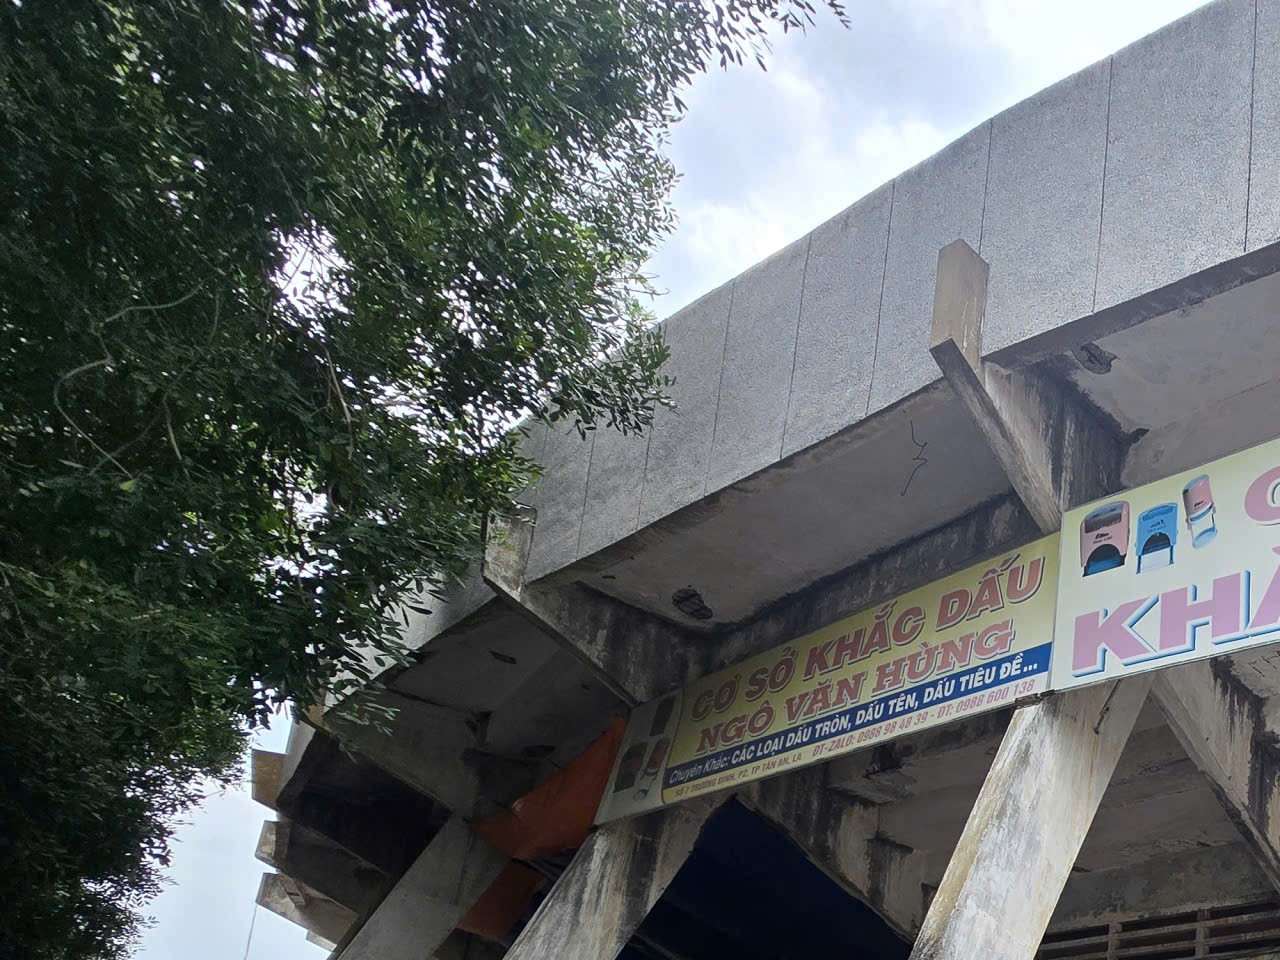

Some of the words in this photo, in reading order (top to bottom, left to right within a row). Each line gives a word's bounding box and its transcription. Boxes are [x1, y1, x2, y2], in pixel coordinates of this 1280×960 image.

[691, 674, 742, 721] CƠ
[745, 646, 798, 701] SỞ
[803, 601, 925, 681] KHẮC
[936, 554, 1045, 632] DẤU
[695, 700, 776, 755] NGÔ
[784, 671, 867, 726] VĂN
[871, 617, 1016, 697] HÙNG
[1013, 679, 1036, 695] 138
[731, 744, 755, 765] CÁC
[756, 735, 784, 757] LOẠI
[786, 723, 812, 747] DẤU
[815, 714, 851, 738] TRÒN,
[855, 701, 885, 726] DẤU
[887, 692, 918, 716] TÊN,
[923, 679, 955, 704] DẤU
[959, 668, 995, 692] TIÊU
